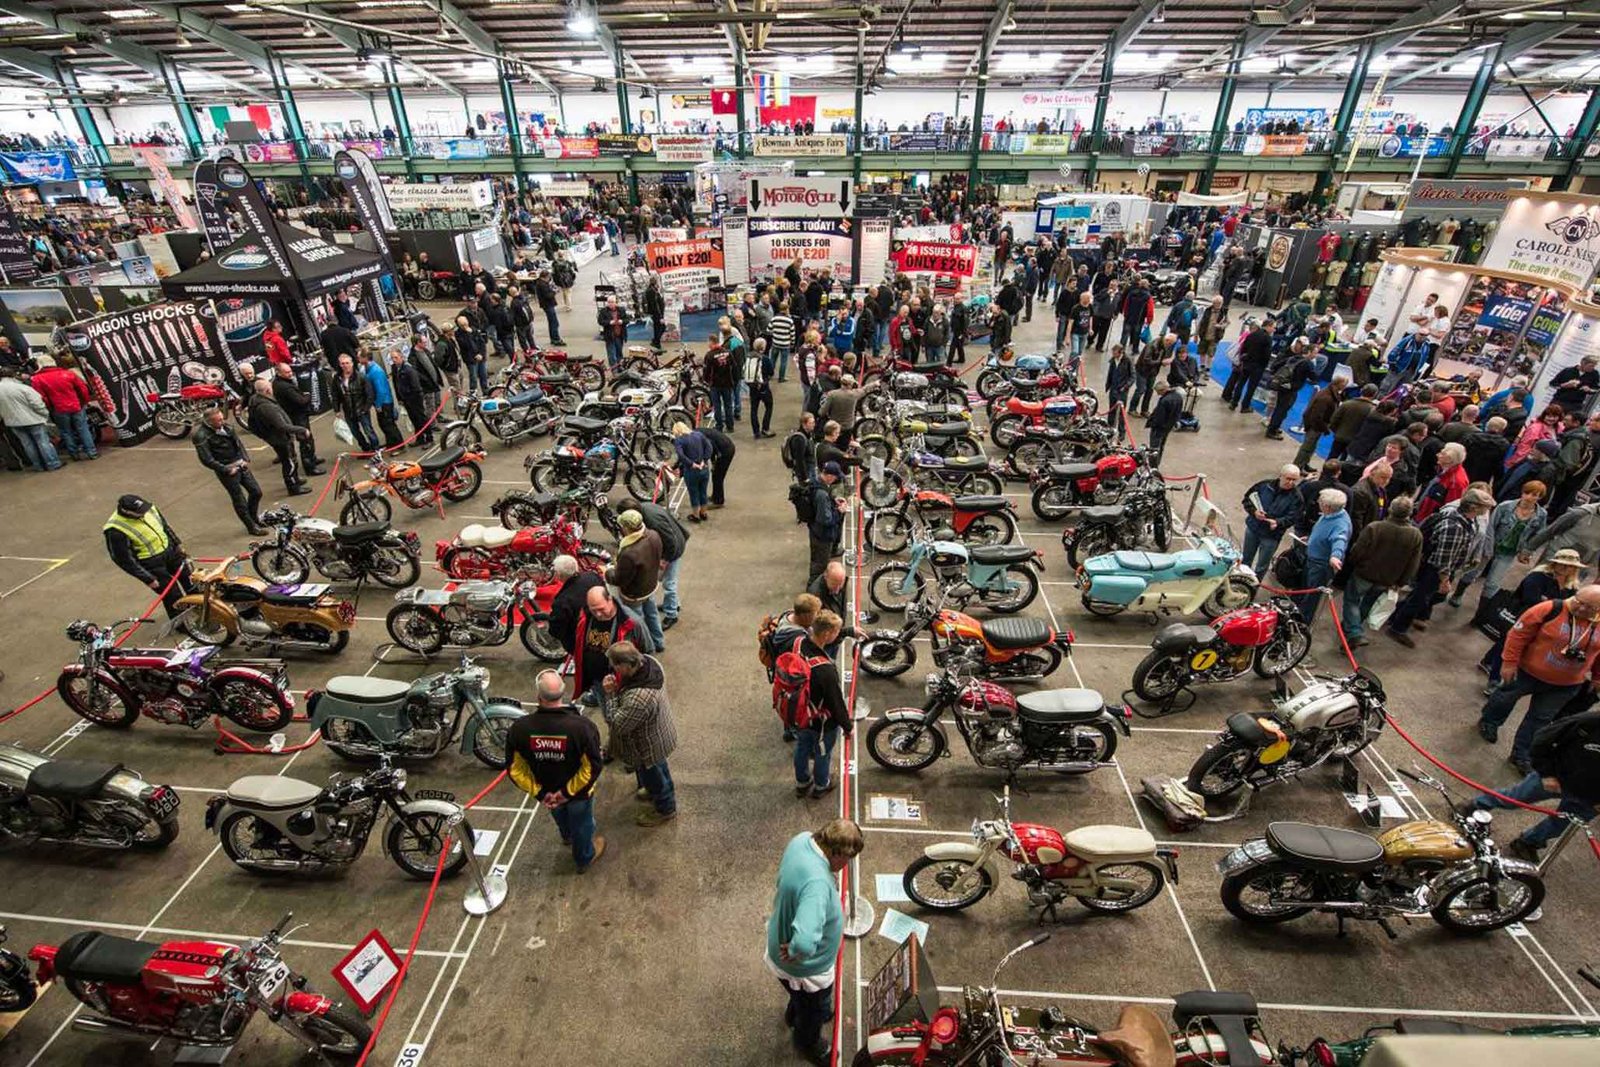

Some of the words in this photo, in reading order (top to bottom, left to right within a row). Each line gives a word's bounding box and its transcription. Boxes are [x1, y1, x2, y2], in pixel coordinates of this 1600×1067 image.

[762, 137, 791, 147] Bowman
[794, 138, 824, 148] Antiques
[827, 138, 844, 147] Fairs
[1415, 183, 1456, 200] Retro
[351, 185, 372, 218] HAGON
[750, 220, 800, 231] SUBSCRIBE
[803, 220, 835, 231] TODAY!
[1566, 223, 1585, 238] CN
[238, 195, 266, 234] HAGON
[262, 235, 292, 278] SHOCKS
[771, 239, 781, 247] 10
[783, 239, 812, 247] ISSUES
[814, 239, 831, 247] FOR
[771, 248, 800, 260] ONLY
[803, 248, 830, 260] £20!
[920, 245, 951, 257] ISSUES
[954, 248, 972, 258] FOR
[1516, 238, 1572, 257] CAROLE
[655, 254, 683, 269] ONLY
[687, 252, 712, 265] £20!
[905, 255, 936, 269] ONLY
[941, 258, 971, 272] £26!
[184, 284, 280, 294] www.hagon-shocks.co.uk
[1489, 302, 1528, 323] rider
[87, 315, 131, 339] HAGON
[132, 303, 196, 326] SHOCKS
[1197, 653, 1211, 668] 7
[535, 738, 562, 749] SWAN
[534, 752, 566, 760] YAMAHA
[263, 967, 286, 992] 36
[181, 985, 218, 997] DUCATI
[397, 1048, 419, 1067] 36
